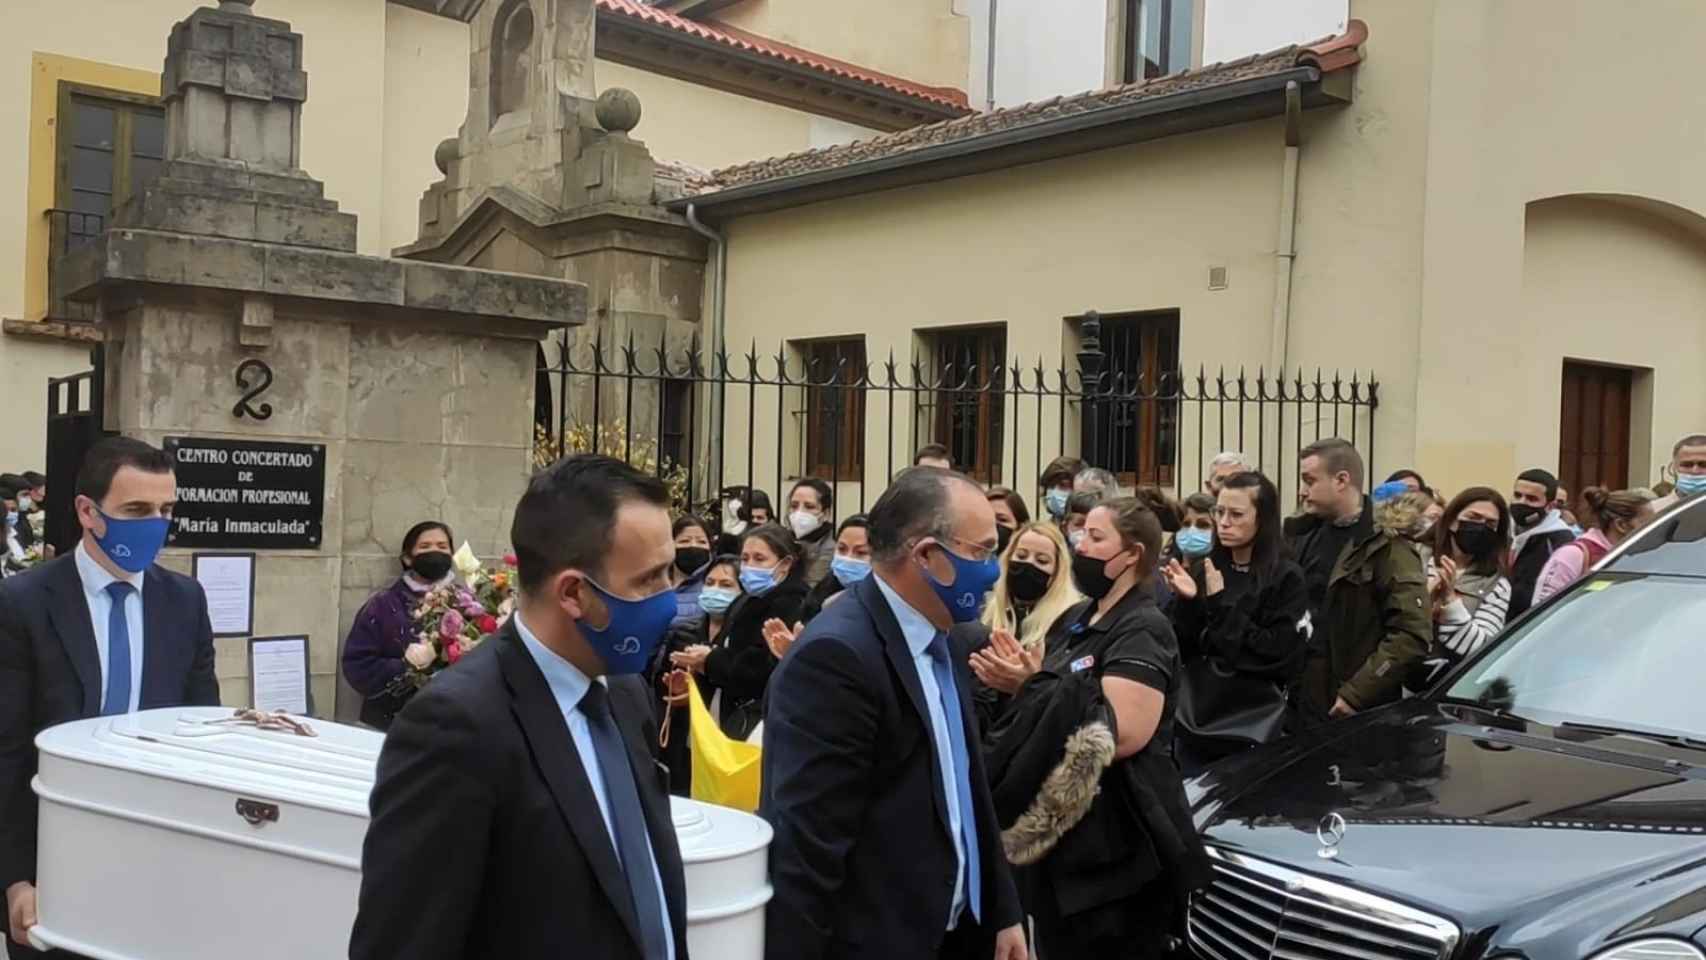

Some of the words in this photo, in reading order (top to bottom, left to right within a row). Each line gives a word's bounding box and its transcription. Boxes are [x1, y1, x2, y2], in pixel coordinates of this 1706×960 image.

[233, 359, 273, 421] 2
[177, 448, 228, 464] CENTRO
[232, 450, 313, 468] CONCERTADO
[238, 471, 254, 482] DE
[176, 487, 238, 503] FORMACION
[242, 489, 312, 505] PROFESIONAL
